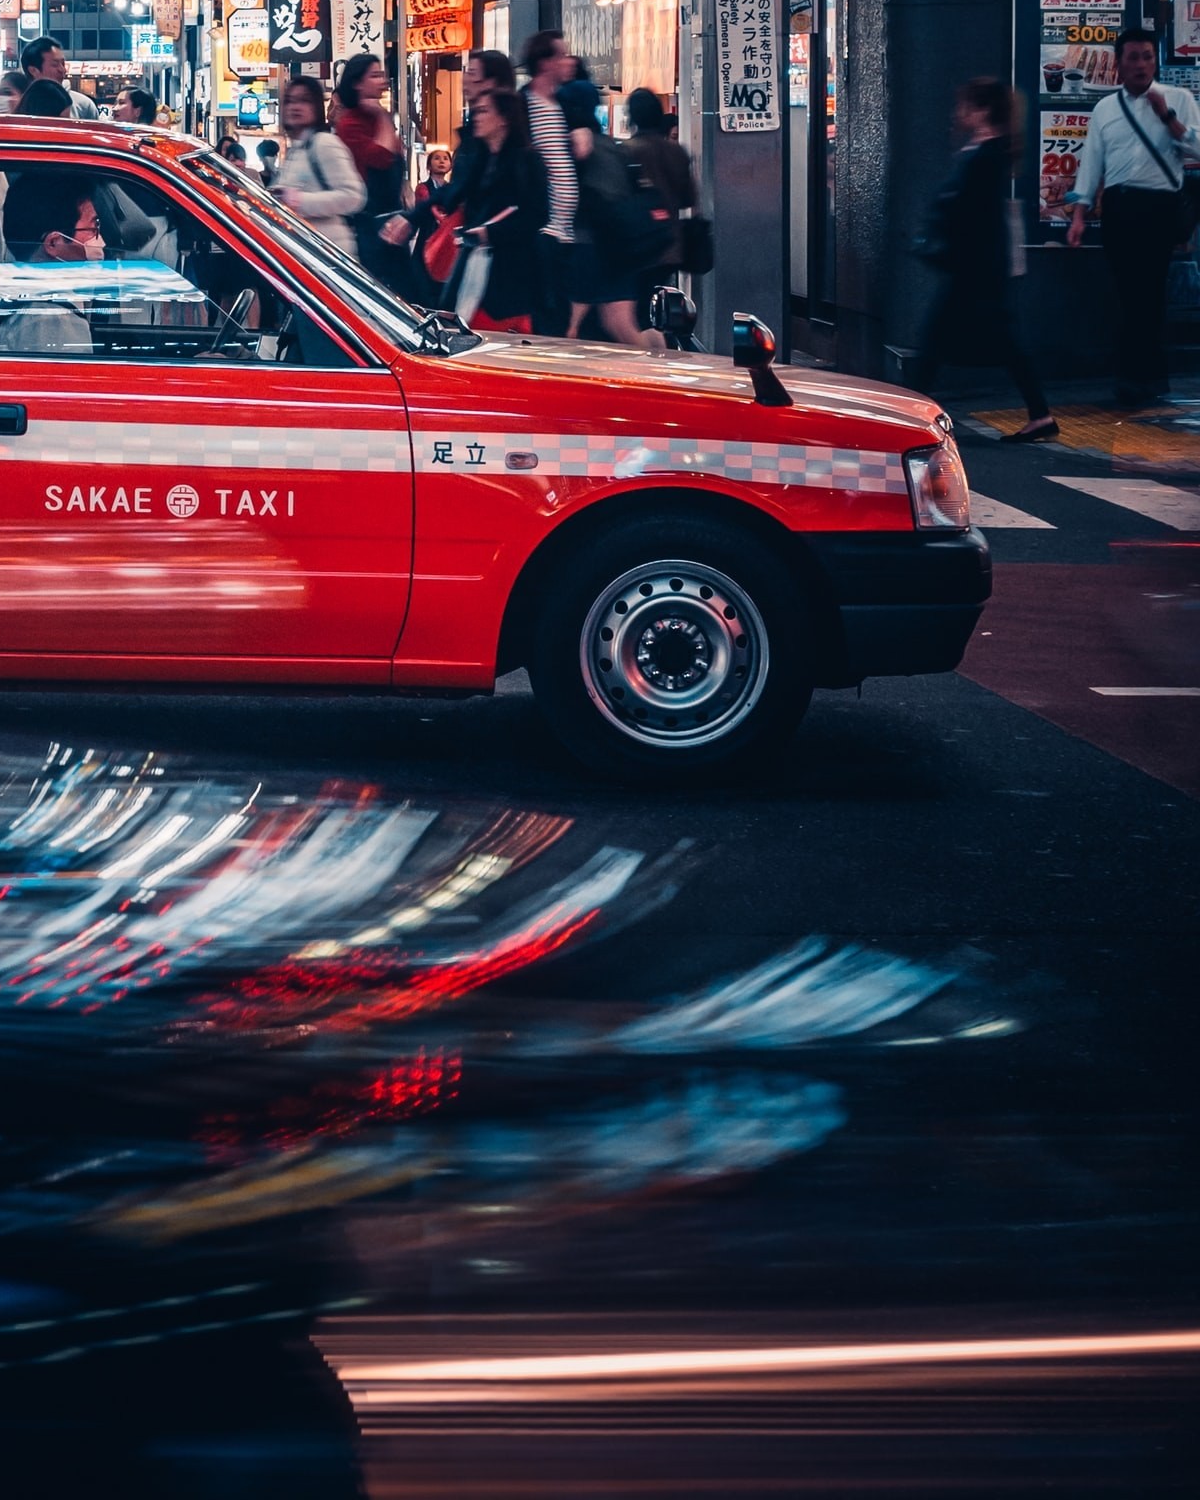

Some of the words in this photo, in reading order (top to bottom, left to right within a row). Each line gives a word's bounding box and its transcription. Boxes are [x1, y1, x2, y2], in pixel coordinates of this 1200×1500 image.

[720, 10, 730, 49] Camera
[738, 121, 765, 129] Police
[431, 441, 488, 467] 足立
[43, 484, 153, 514] SAKAE
[213, 488, 296, 518] TAXI
